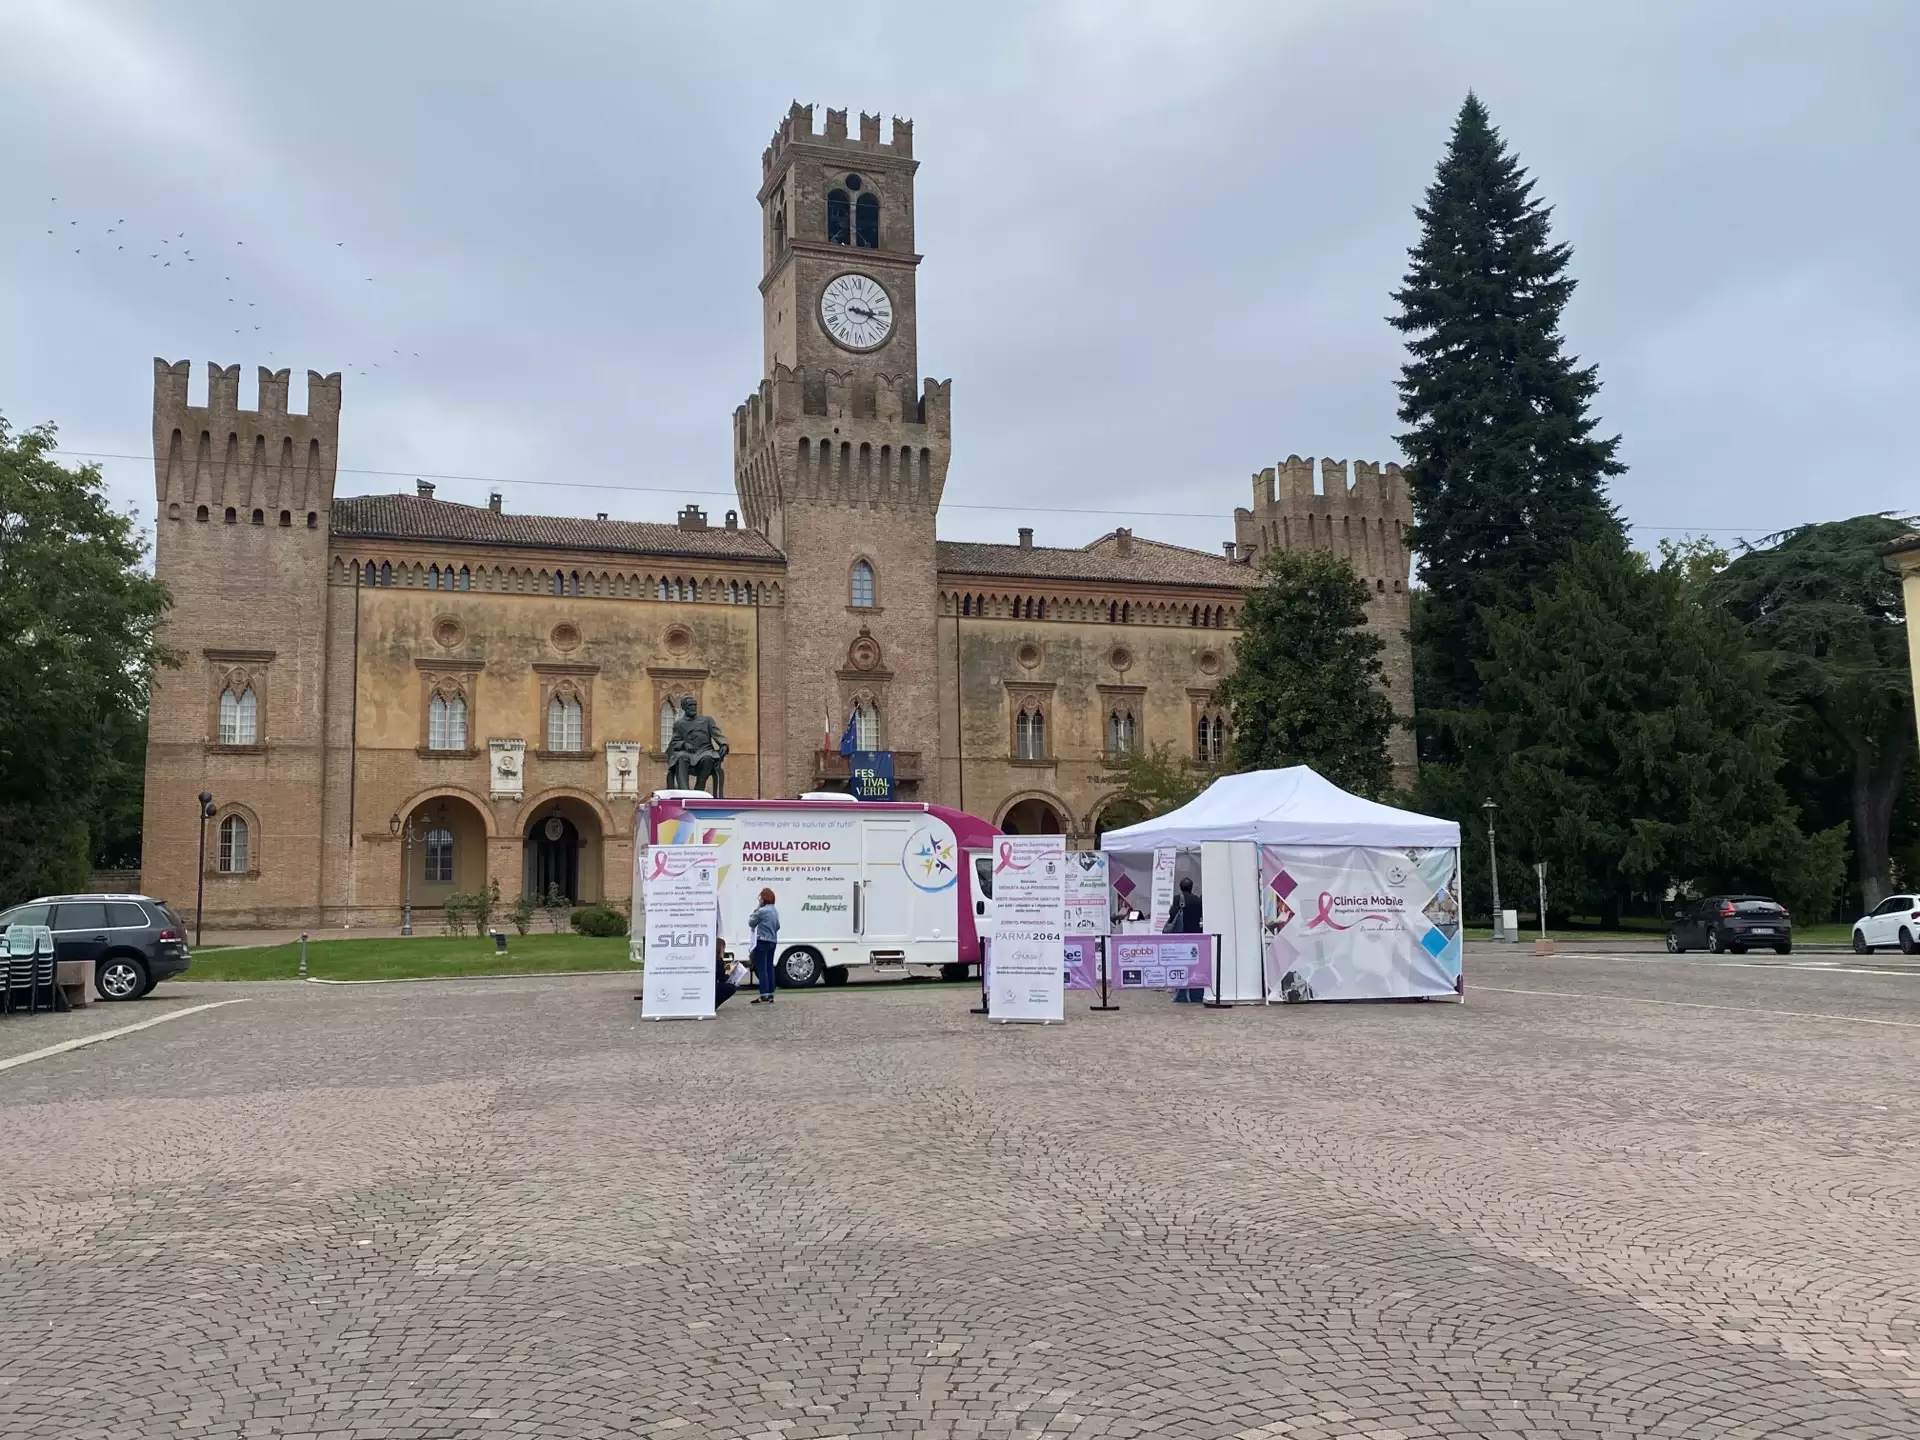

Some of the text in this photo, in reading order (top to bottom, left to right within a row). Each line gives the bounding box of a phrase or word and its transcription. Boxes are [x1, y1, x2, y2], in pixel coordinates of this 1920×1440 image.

[855, 769, 874, 778] FES
[862, 778, 890, 787] TIVAL
[856, 787, 888, 796] VERDI
[777, 821, 790, 829] per
[828, 820, 835, 828] di
[742, 841, 831, 850] AMBULATORIO
[742, 853, 789, 862] MOBILE
[1333, 896, 1404, 906] Clinica Mobile
[801, 902, 848, 913] Analysis
[651, 931, 709, 948] sicim
[1130, 947, 1154, 958] gobbi
